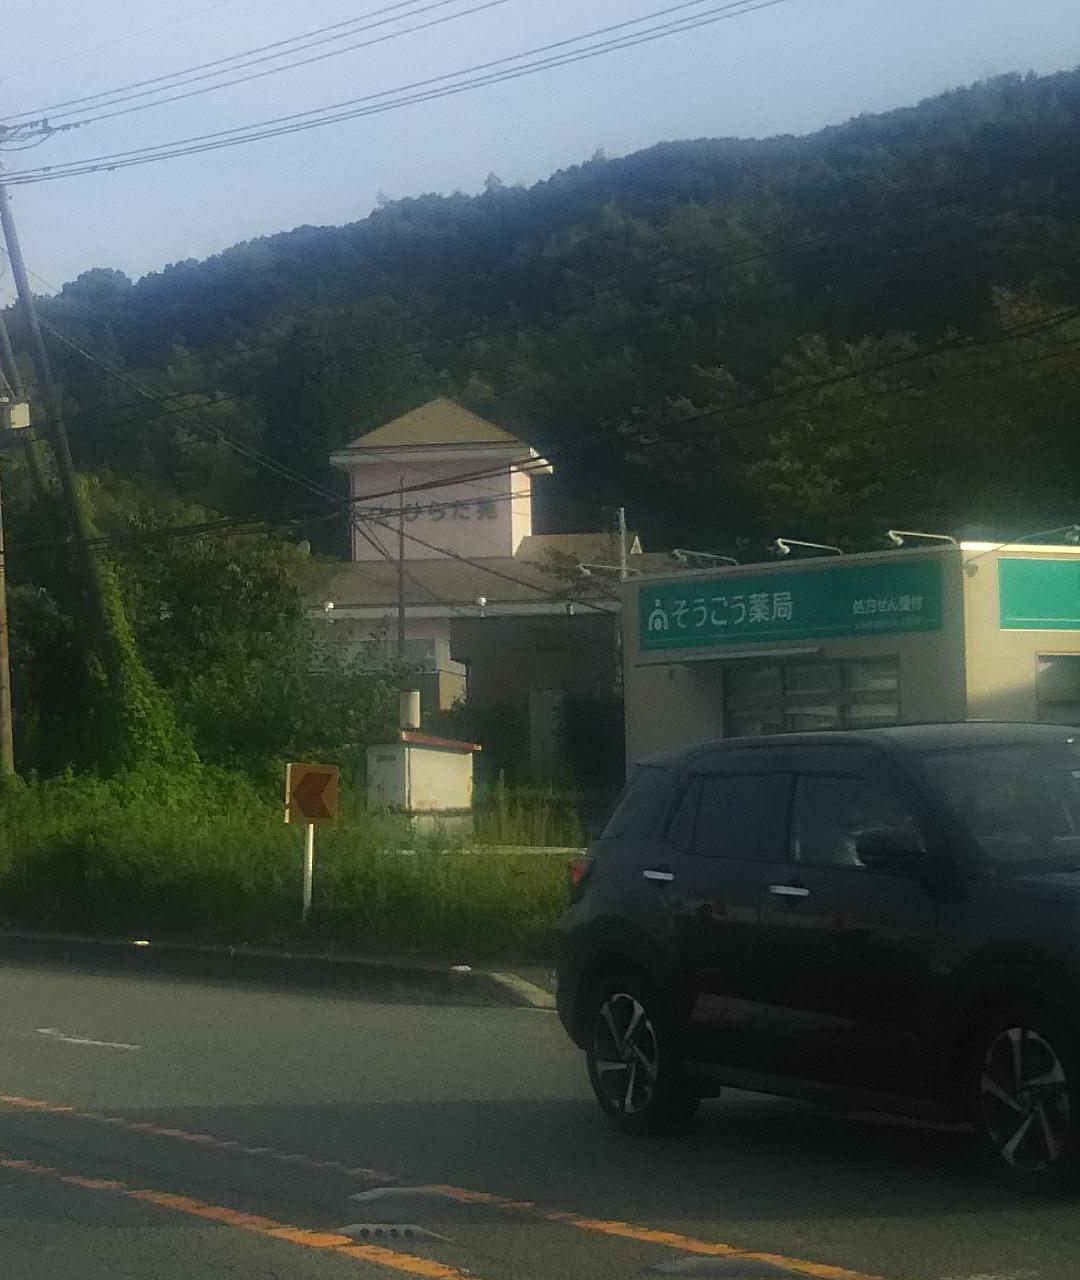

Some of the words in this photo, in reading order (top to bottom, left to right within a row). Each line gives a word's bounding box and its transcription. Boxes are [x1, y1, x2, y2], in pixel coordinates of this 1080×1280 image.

[672, 591, 792, 629] そうごう薬局
